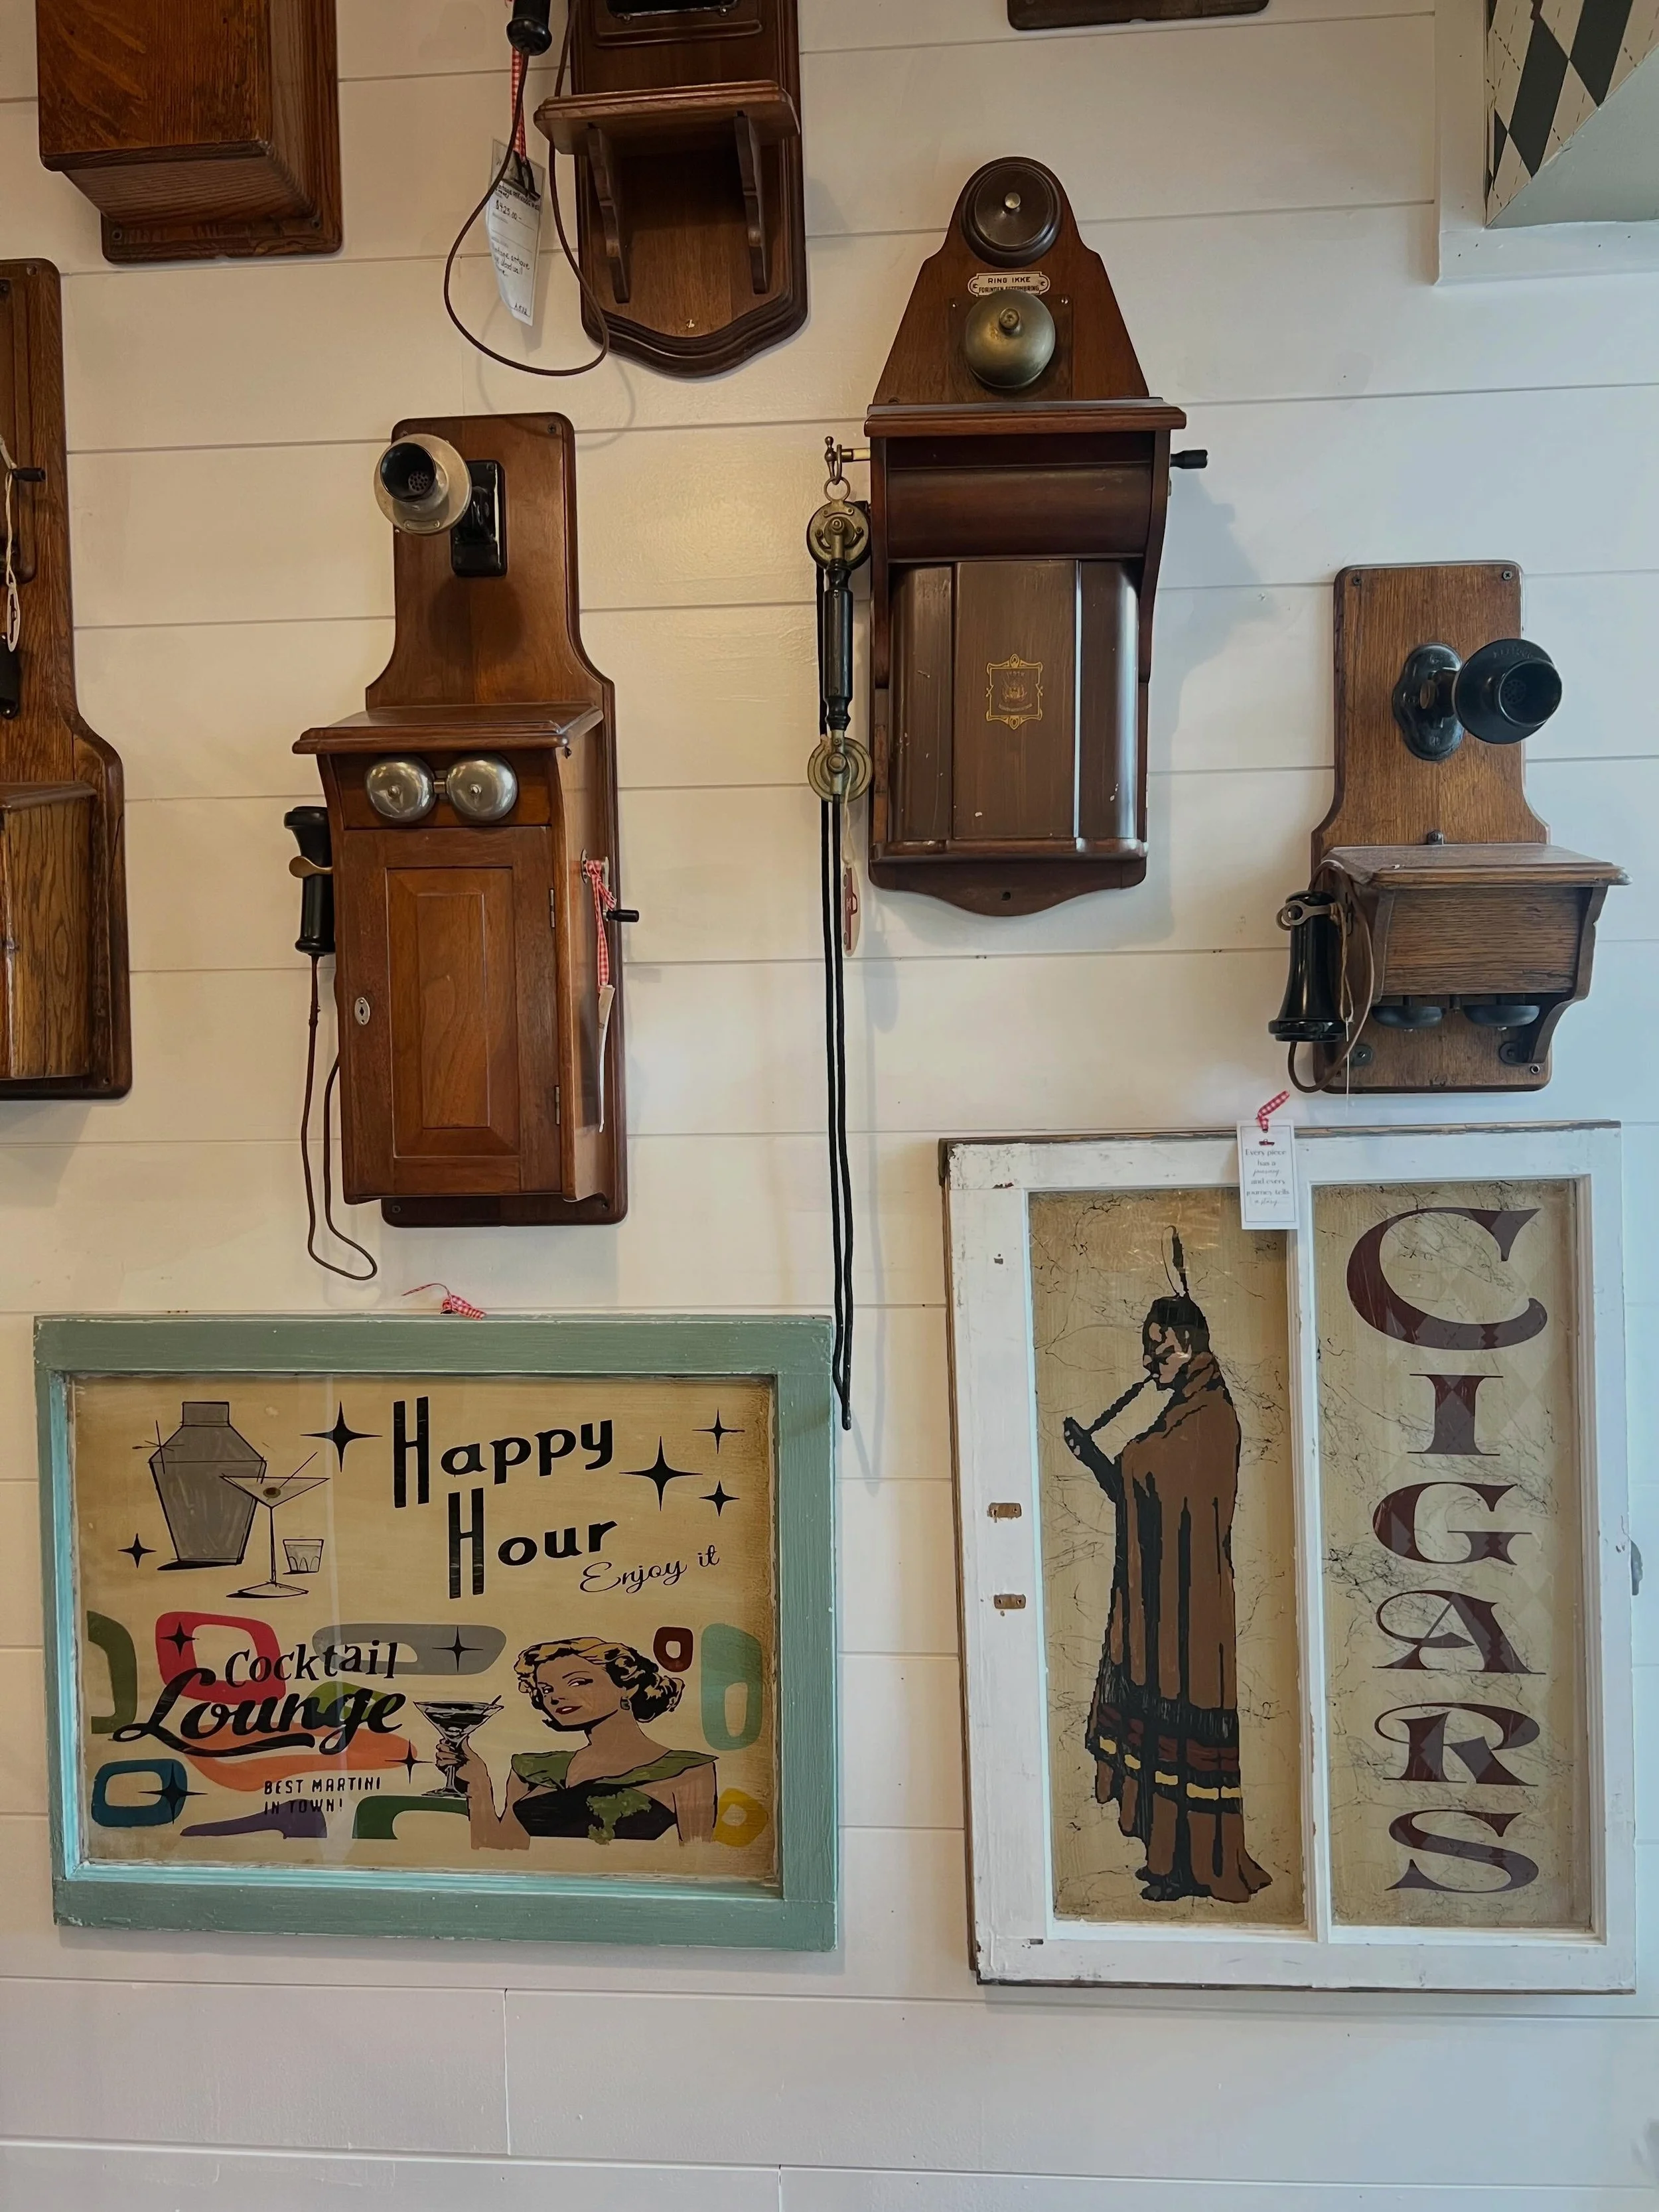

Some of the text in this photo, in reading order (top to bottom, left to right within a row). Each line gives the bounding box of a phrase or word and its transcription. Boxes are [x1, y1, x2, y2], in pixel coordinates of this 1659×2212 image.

[393, 1396, 613, 1509] Happy
[448, 1487, 618, 1599] Hour
[579, 1544, 721, 1594] Enjoy it
[1346, 1207, 1548, 1893] CIGARS
[225, 1639, 397, 1688] Cocktail
[112, 1666, 407, 1757] Lounge
[264, 1777, 382, 1795] BEST MARTINI
[264, 1798, 344, 1815] IN TOWN!
